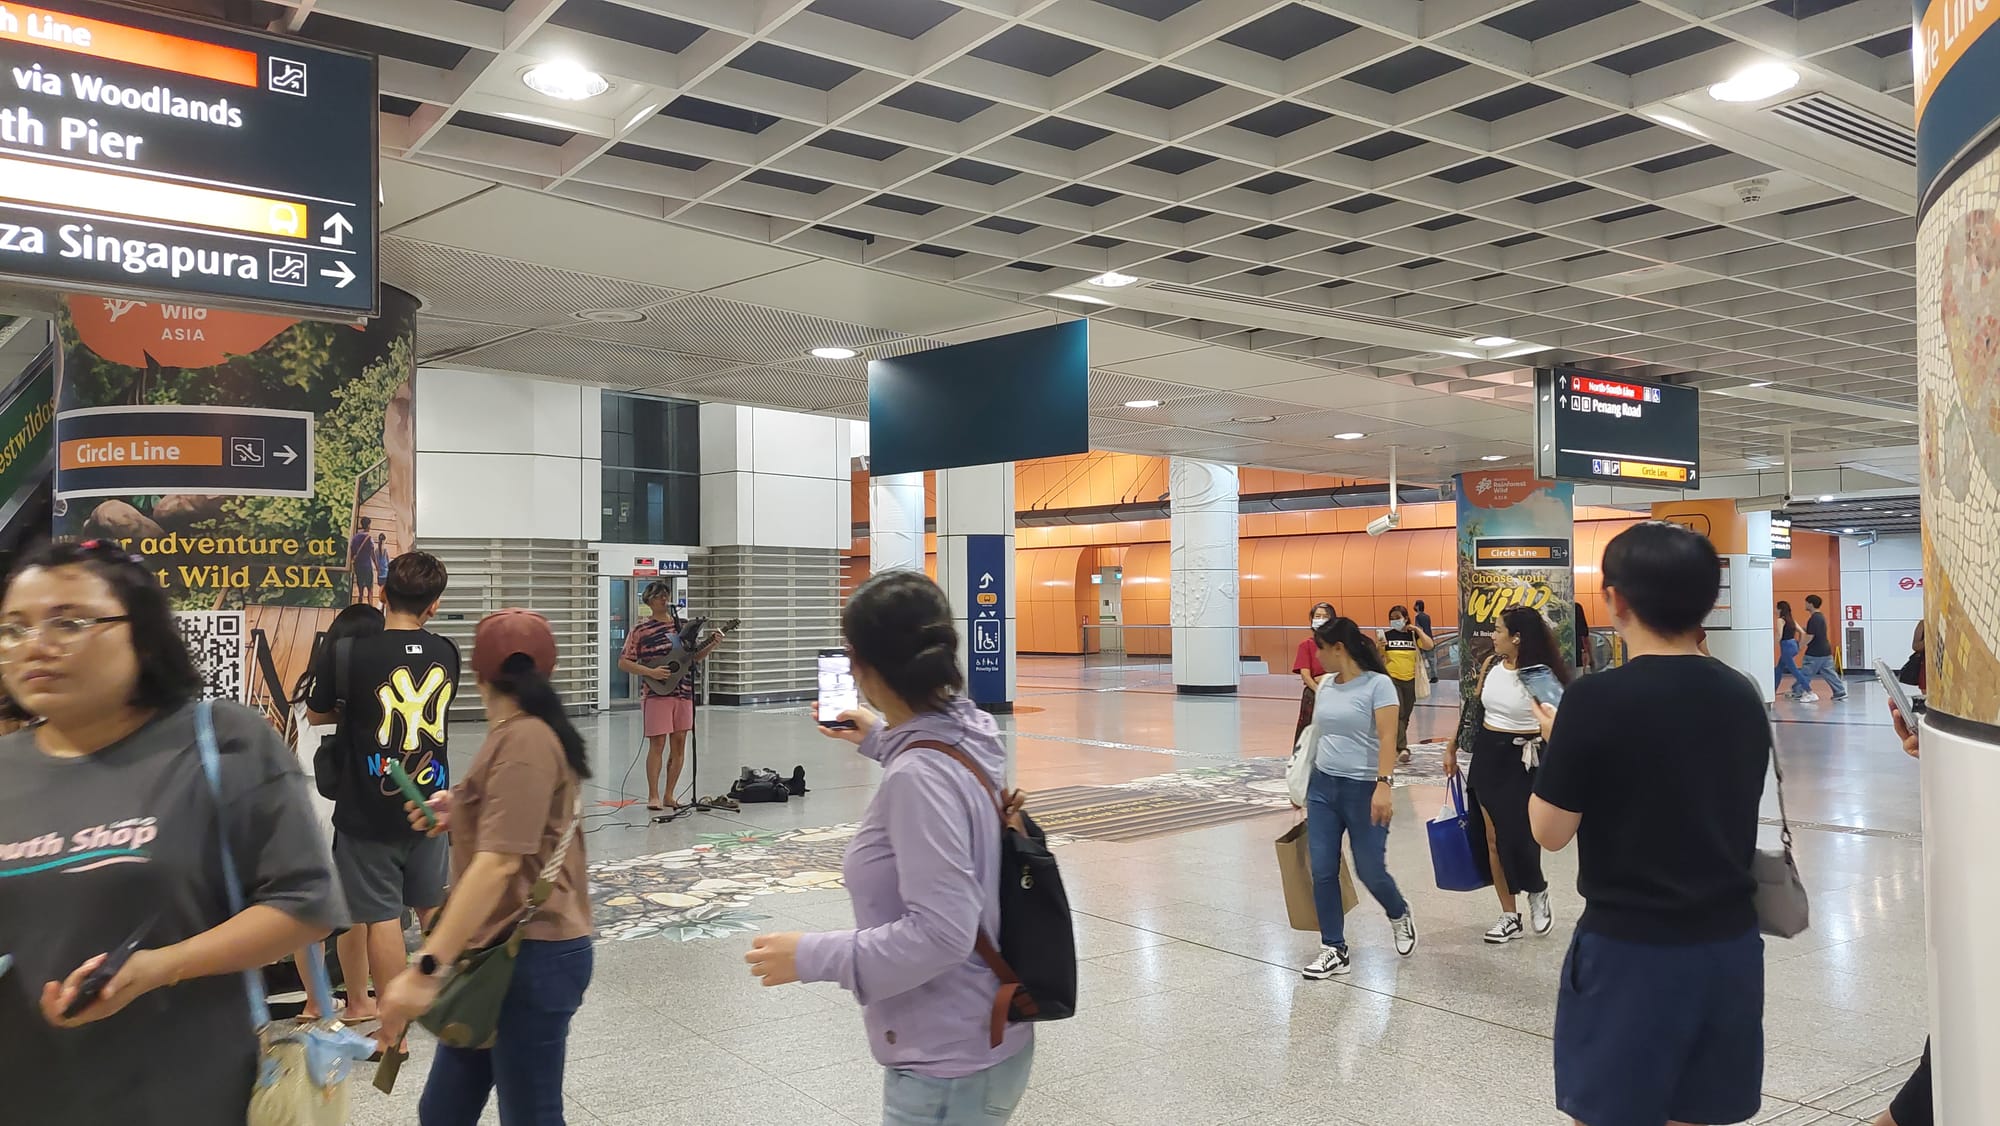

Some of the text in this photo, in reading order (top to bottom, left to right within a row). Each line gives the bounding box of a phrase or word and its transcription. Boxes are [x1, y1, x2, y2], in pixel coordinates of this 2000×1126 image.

[27, 13, 92, 47] Line
[1944, 0, 1989, 52] Lin
[12, 62, 243, 129] via Woodlands
[60, 116, 144, 162] Pier
[59, 223, 259, 280] Singapura
[161, 328, 205, 341] ASIA
[1592, 399, 1621, 418] Penang
[1622, 403, 1642, 417] Road
[77, 441, 180, 463] Circle Line
[1642, 466, 1657, 477] Circle
[140, 532, 299, 555] adventure
[308, 537, 337, 556] at
[1490, 549, 1537, 557] Circle Line
[177, 565, 251, 589] Wild
[259, 565, 334, 589] ASIA
[1471, 573, 1547, 585] Choose your
[67, 823, 159, 852] Shop
